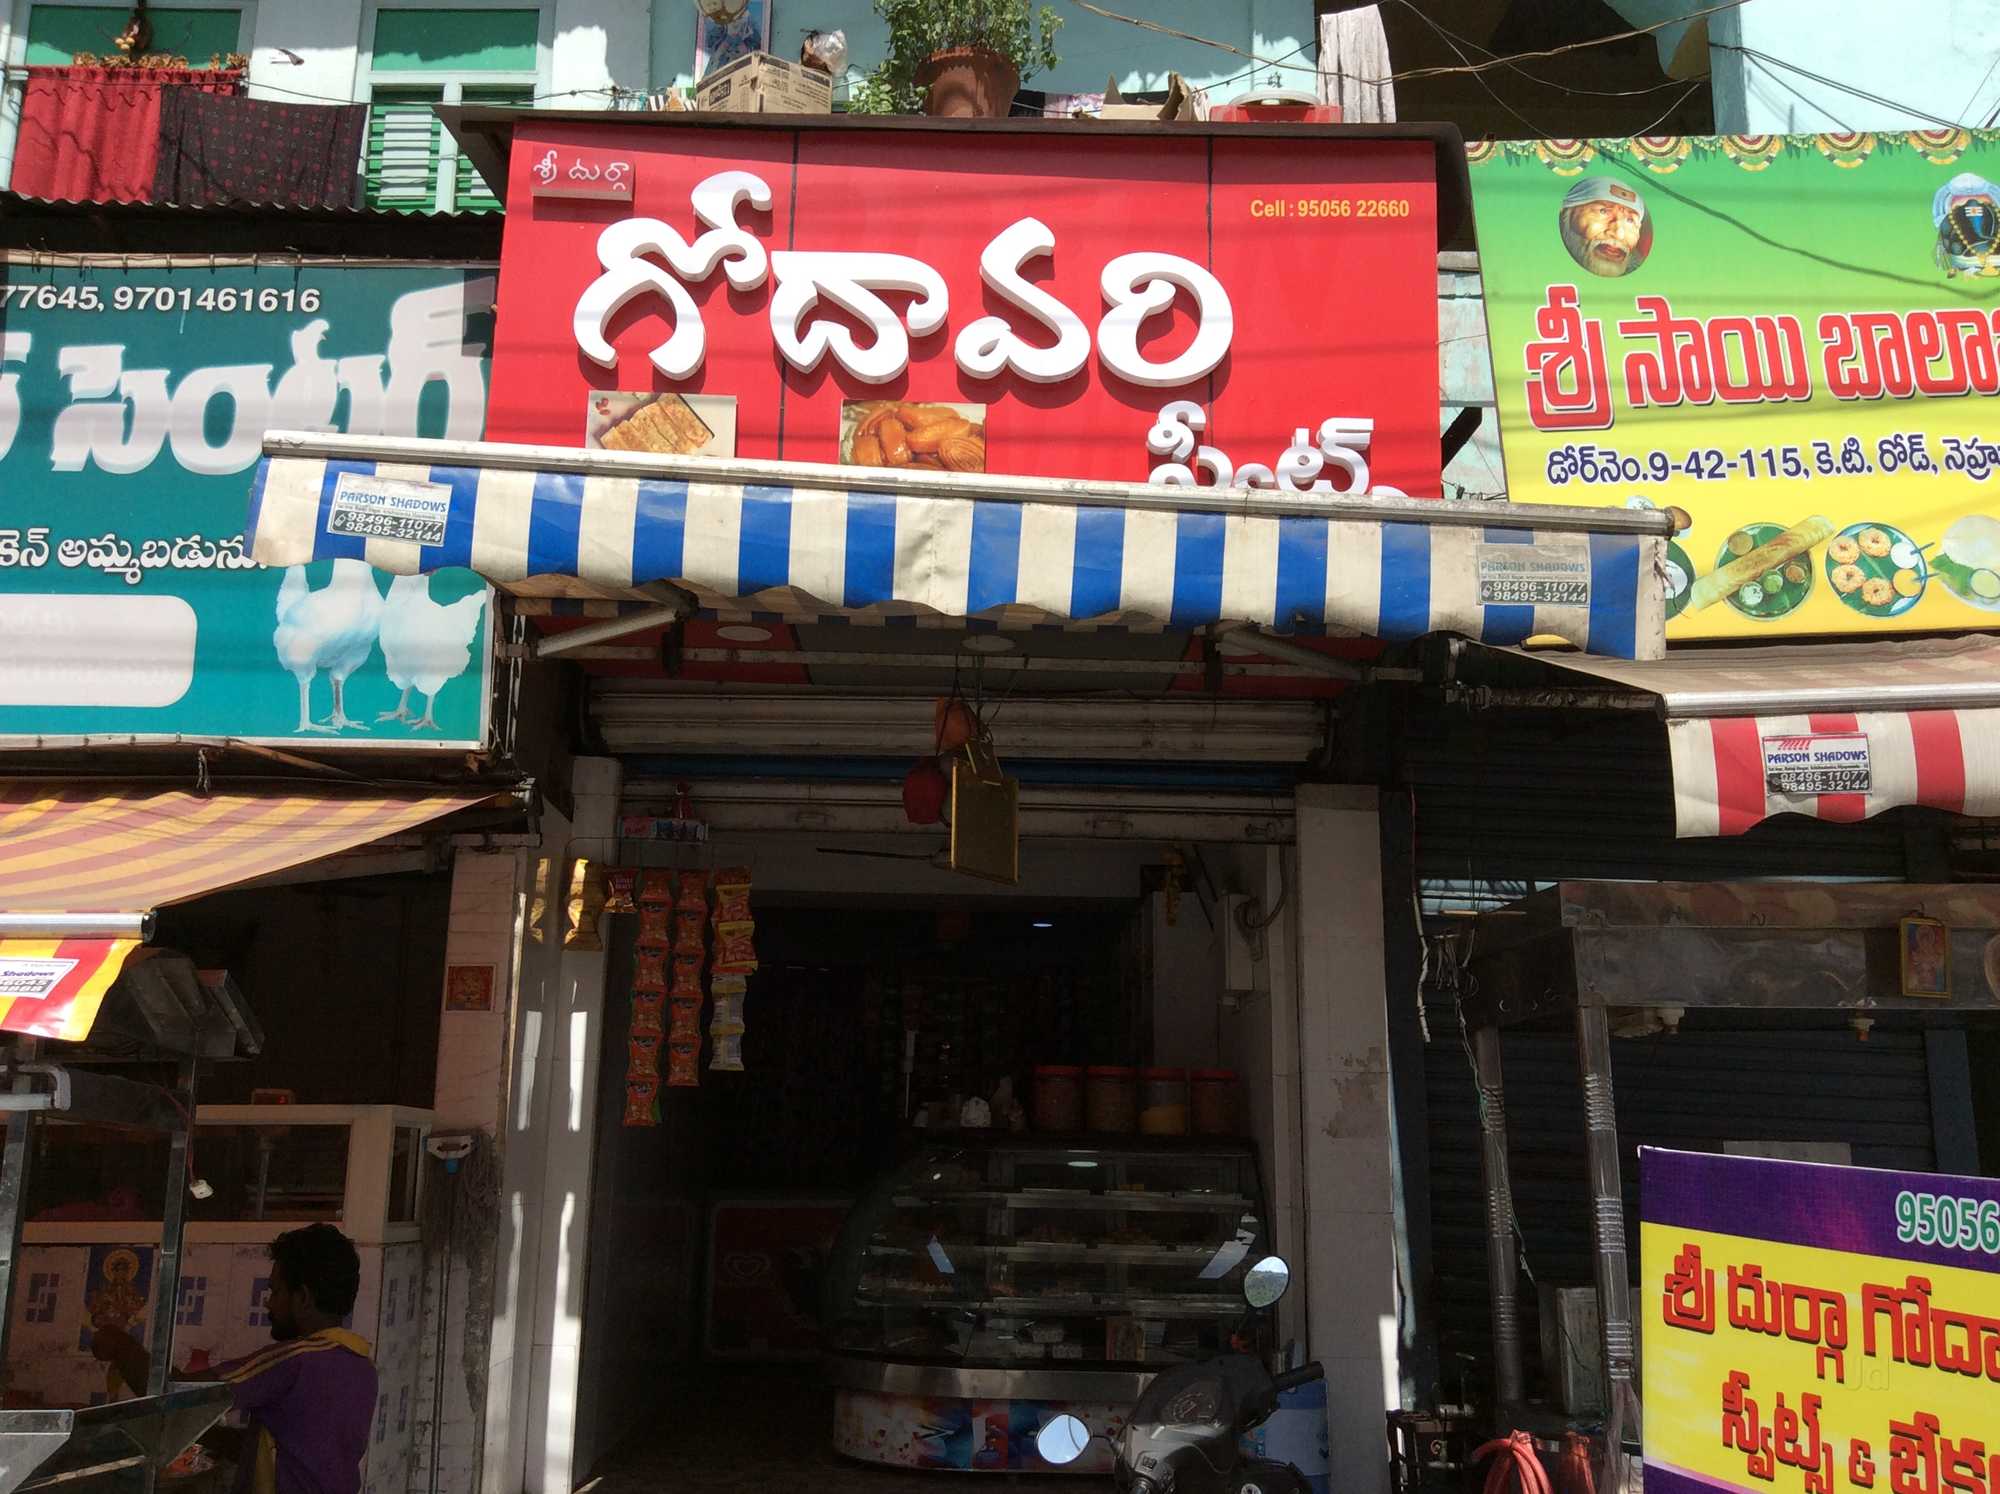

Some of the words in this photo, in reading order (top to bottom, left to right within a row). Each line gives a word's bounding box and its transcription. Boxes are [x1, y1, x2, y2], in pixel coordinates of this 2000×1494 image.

[533, 150, 558, 185] శ్రీ
[1250, 200, 1285, 217] Cell
[1298, 200, 1351, 217] 95056
[1356, 200, 1409, 217] 22660
[573, 170, 1234, 388] గోదావరి
[113, 286, 321, 313] 9701461616
[1525, 284, 1614, 432] శ్రీ
[1619, 295, 1813, 408] సాయి
[1818, 307, 2000, 400] బాలా
[1942, 436, 2000, 481] నెహ్ర
[340, 491, 386, 505] PARSON
[390, 496, 447, 513] SHADOWS
[345, 521, 441, 542] 98495-32144
[347, 511, 442, 531] 98496-11077
[1493, 582, 1585, 592] 98496-11077
[1493, 592, 1586, 602] 98495-32144
[1768, 753, 1810, 764] PARSON
[1815, 751, 1867, 763] SHADOWS
[1663, 1243, 1715, 1334] శ్రీ
